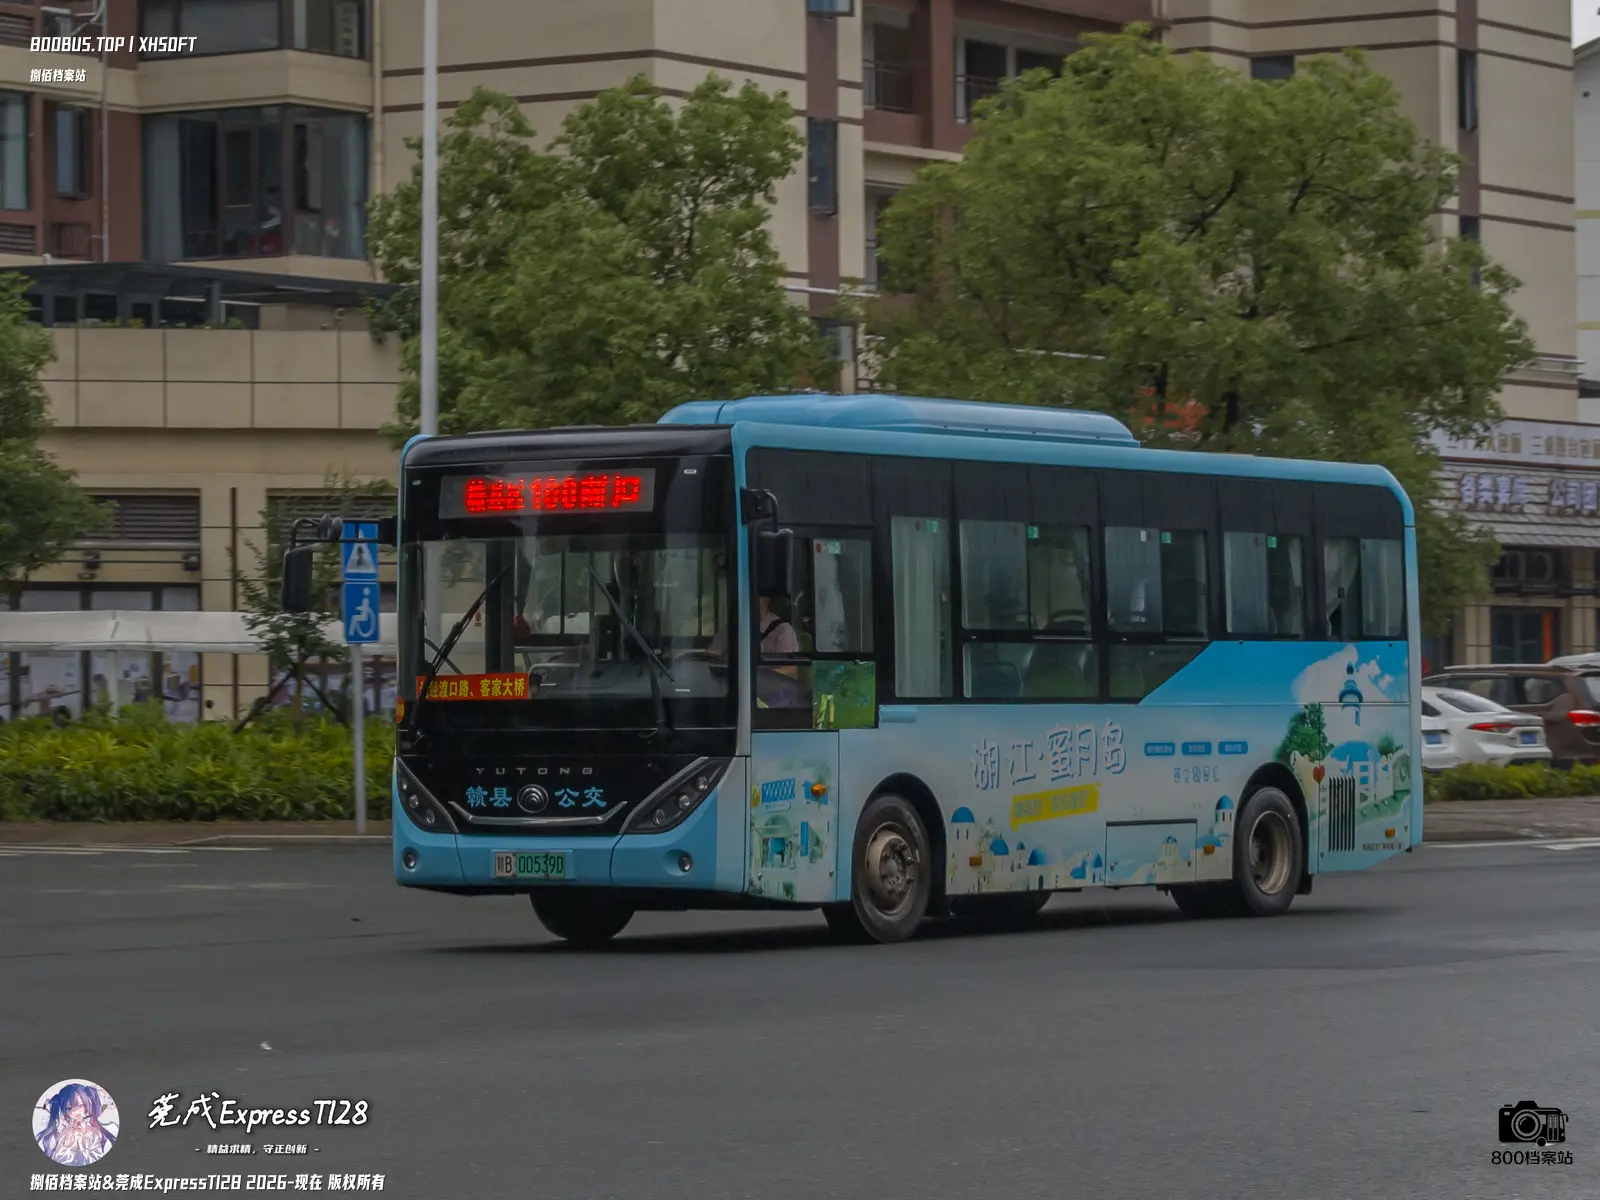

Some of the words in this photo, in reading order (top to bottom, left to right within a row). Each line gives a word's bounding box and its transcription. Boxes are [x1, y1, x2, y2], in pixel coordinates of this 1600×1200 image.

[475, 767, 594, 776] YUTONG
[465, 785, 513, 808] 赣县
[554, 786, 607, 808] 公交
